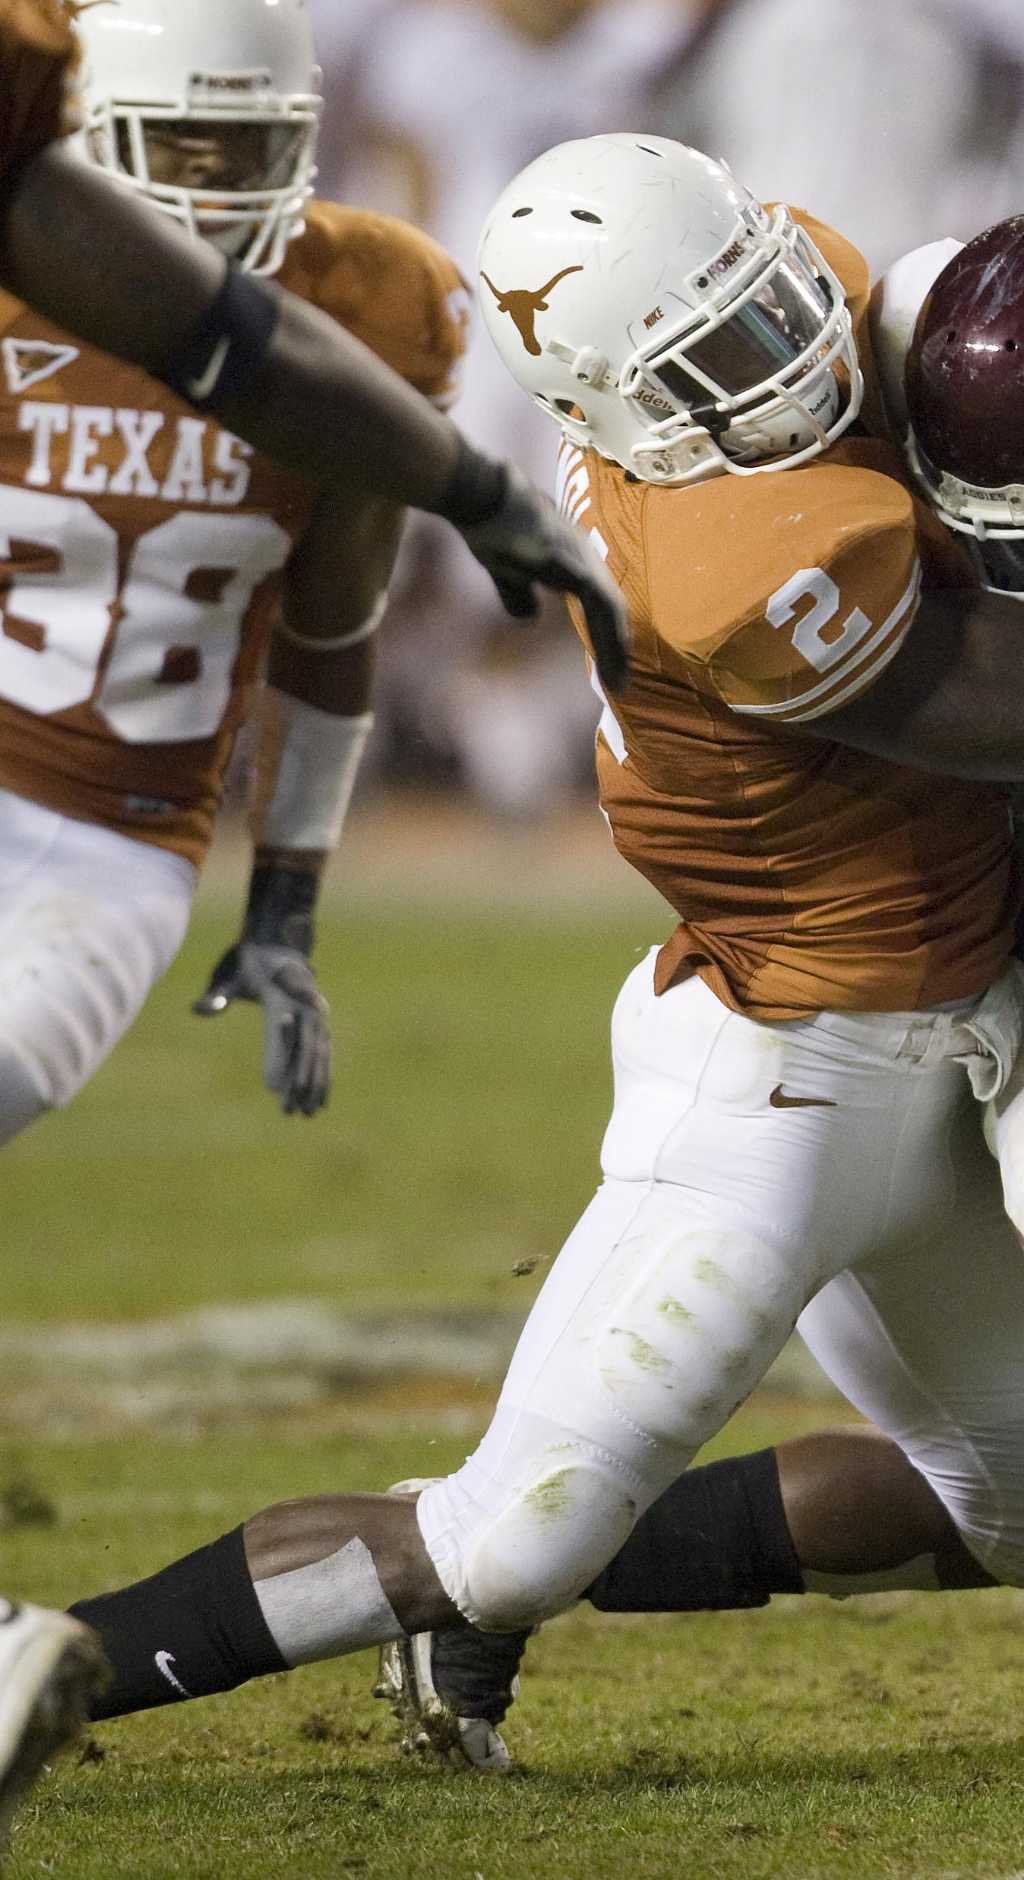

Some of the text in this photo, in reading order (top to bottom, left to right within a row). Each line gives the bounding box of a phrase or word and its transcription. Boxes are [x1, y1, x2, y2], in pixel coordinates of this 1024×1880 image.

[18, 401, 255, 506] TEXAS
[0, 483, 293, 745] 38
[764, 567, 873, 674] 2
